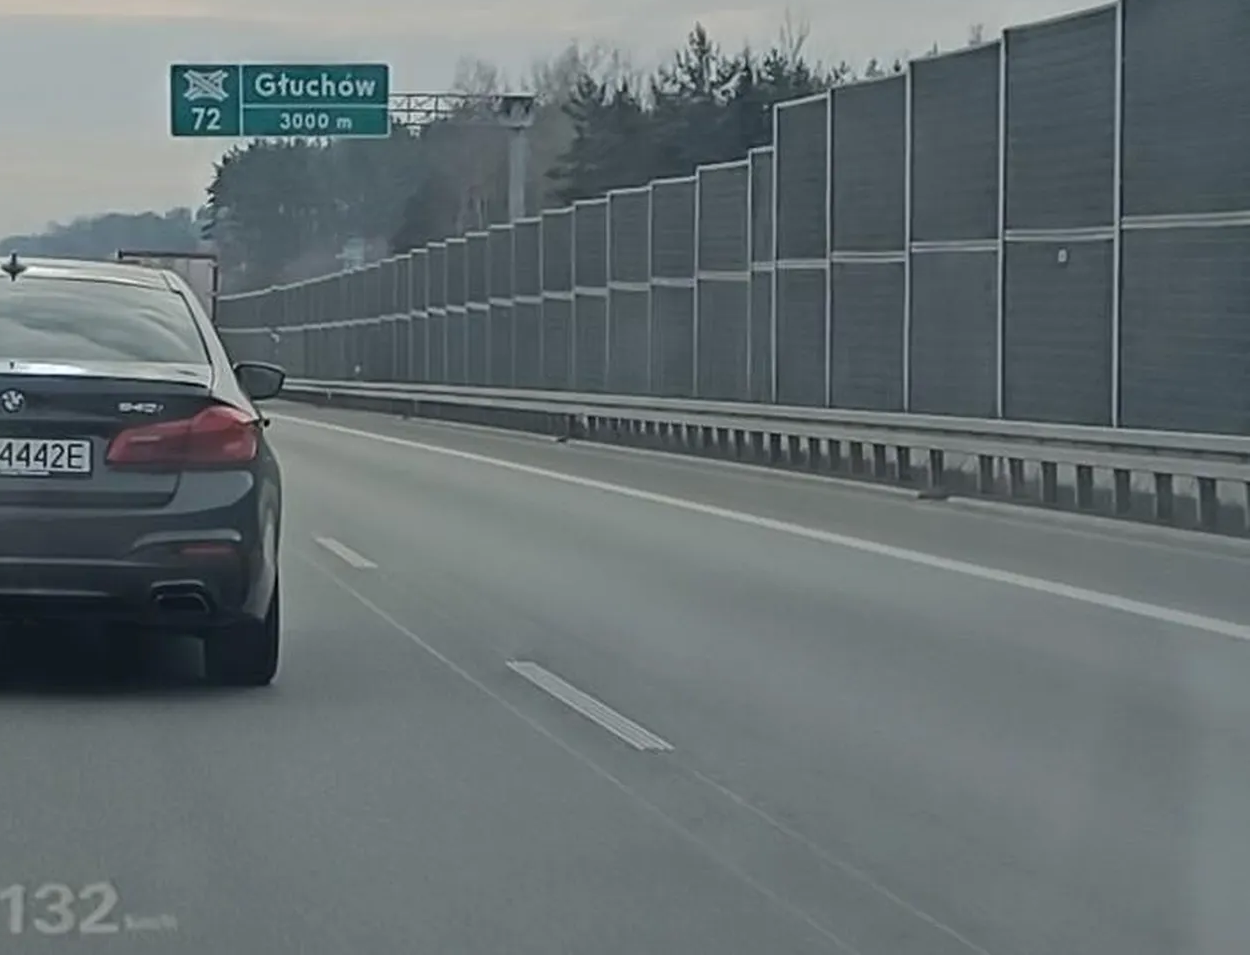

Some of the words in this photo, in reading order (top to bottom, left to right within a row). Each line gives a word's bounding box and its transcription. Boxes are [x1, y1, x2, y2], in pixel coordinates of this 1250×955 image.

[254, 72, 376, 97] Głuchów
[191, 107, 221, 130] 72
[279, 113, 330, 130] 3000
[336, 116, 353, 130] m
